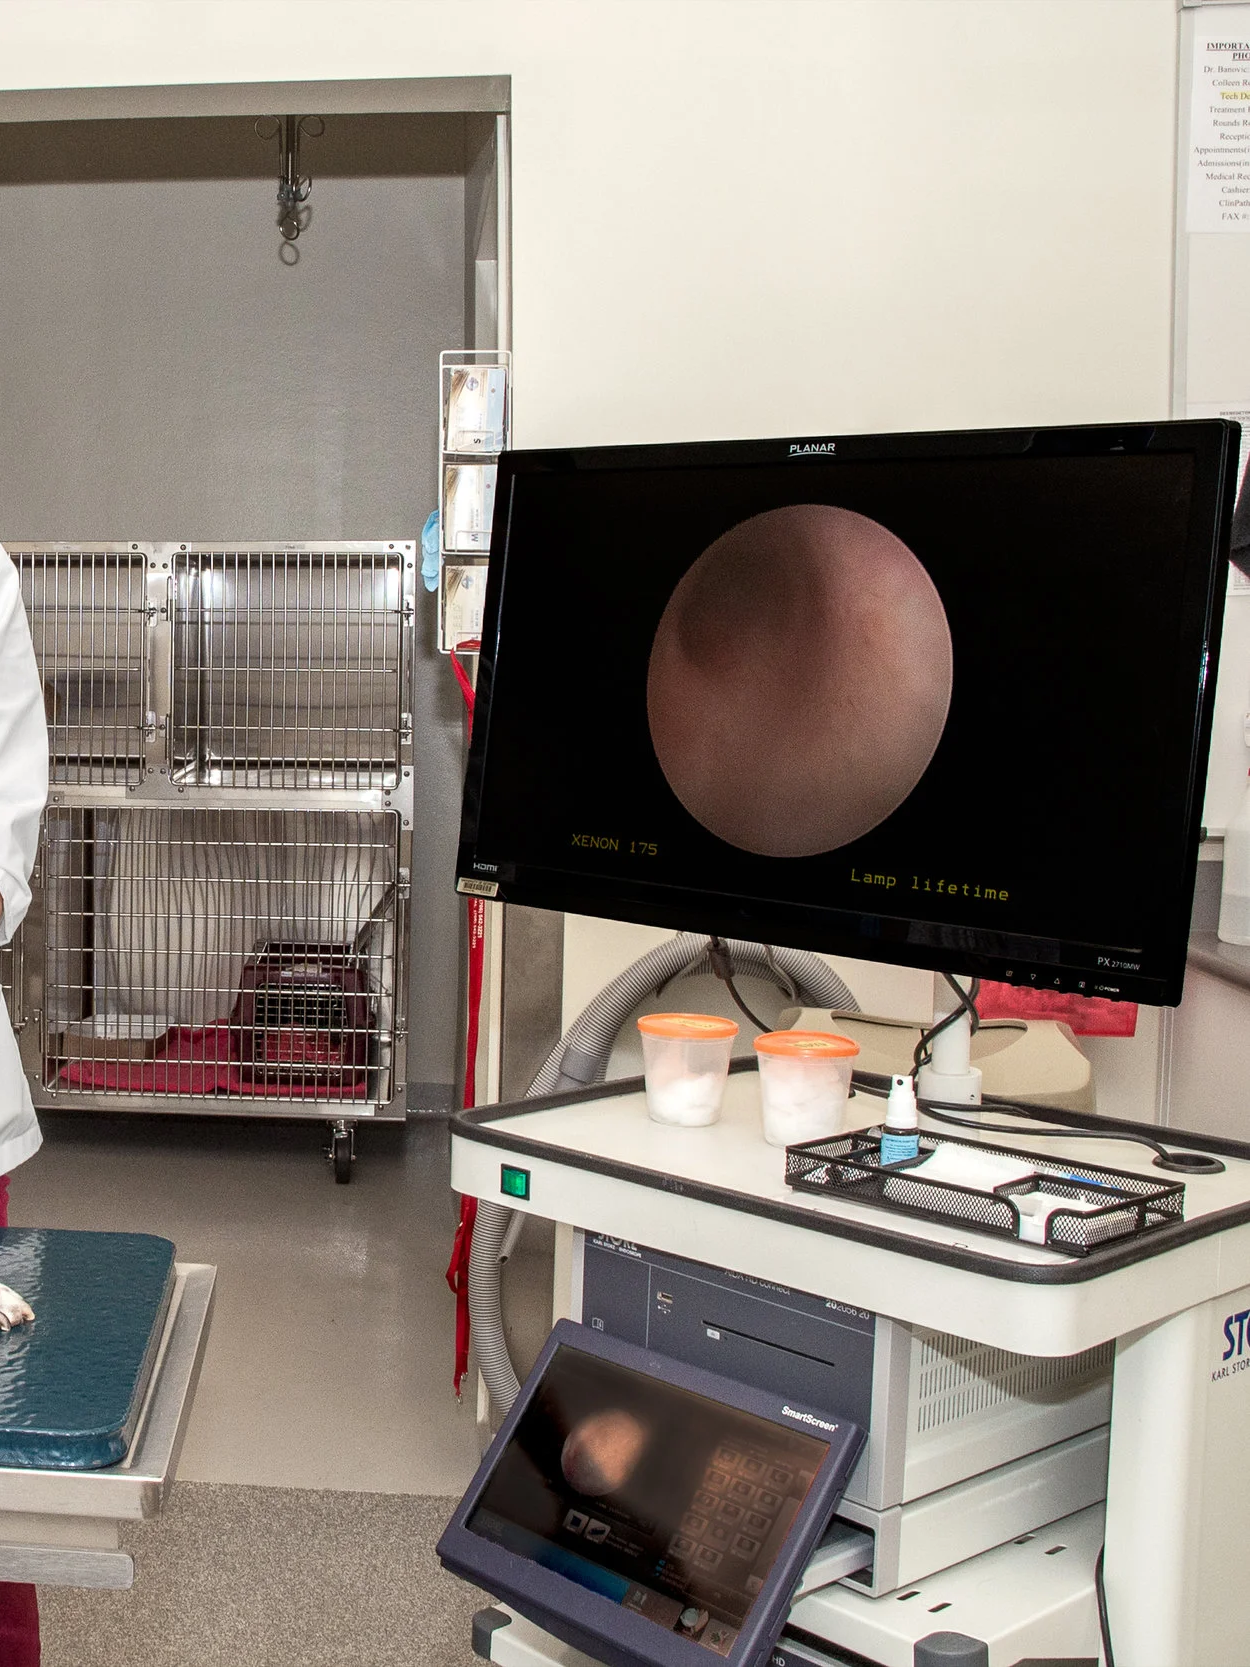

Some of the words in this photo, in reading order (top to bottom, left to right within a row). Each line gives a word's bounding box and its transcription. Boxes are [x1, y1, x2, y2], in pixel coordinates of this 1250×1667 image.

[1221, 92, 1239, 100] Tech
[789, 442, 836, 454] PLANAR
[571, 833, 619, 851] XENON
[630, 841, 658, 856] 175
[850, 868, 897, 889] Lamp
[911, 876, 1009, 901] lifetime
[1097, 956, 1110, 967] PX
[1111, 960, 1141, 971] 2710MW
[1211, 1366, 1230, 1382] KARL
